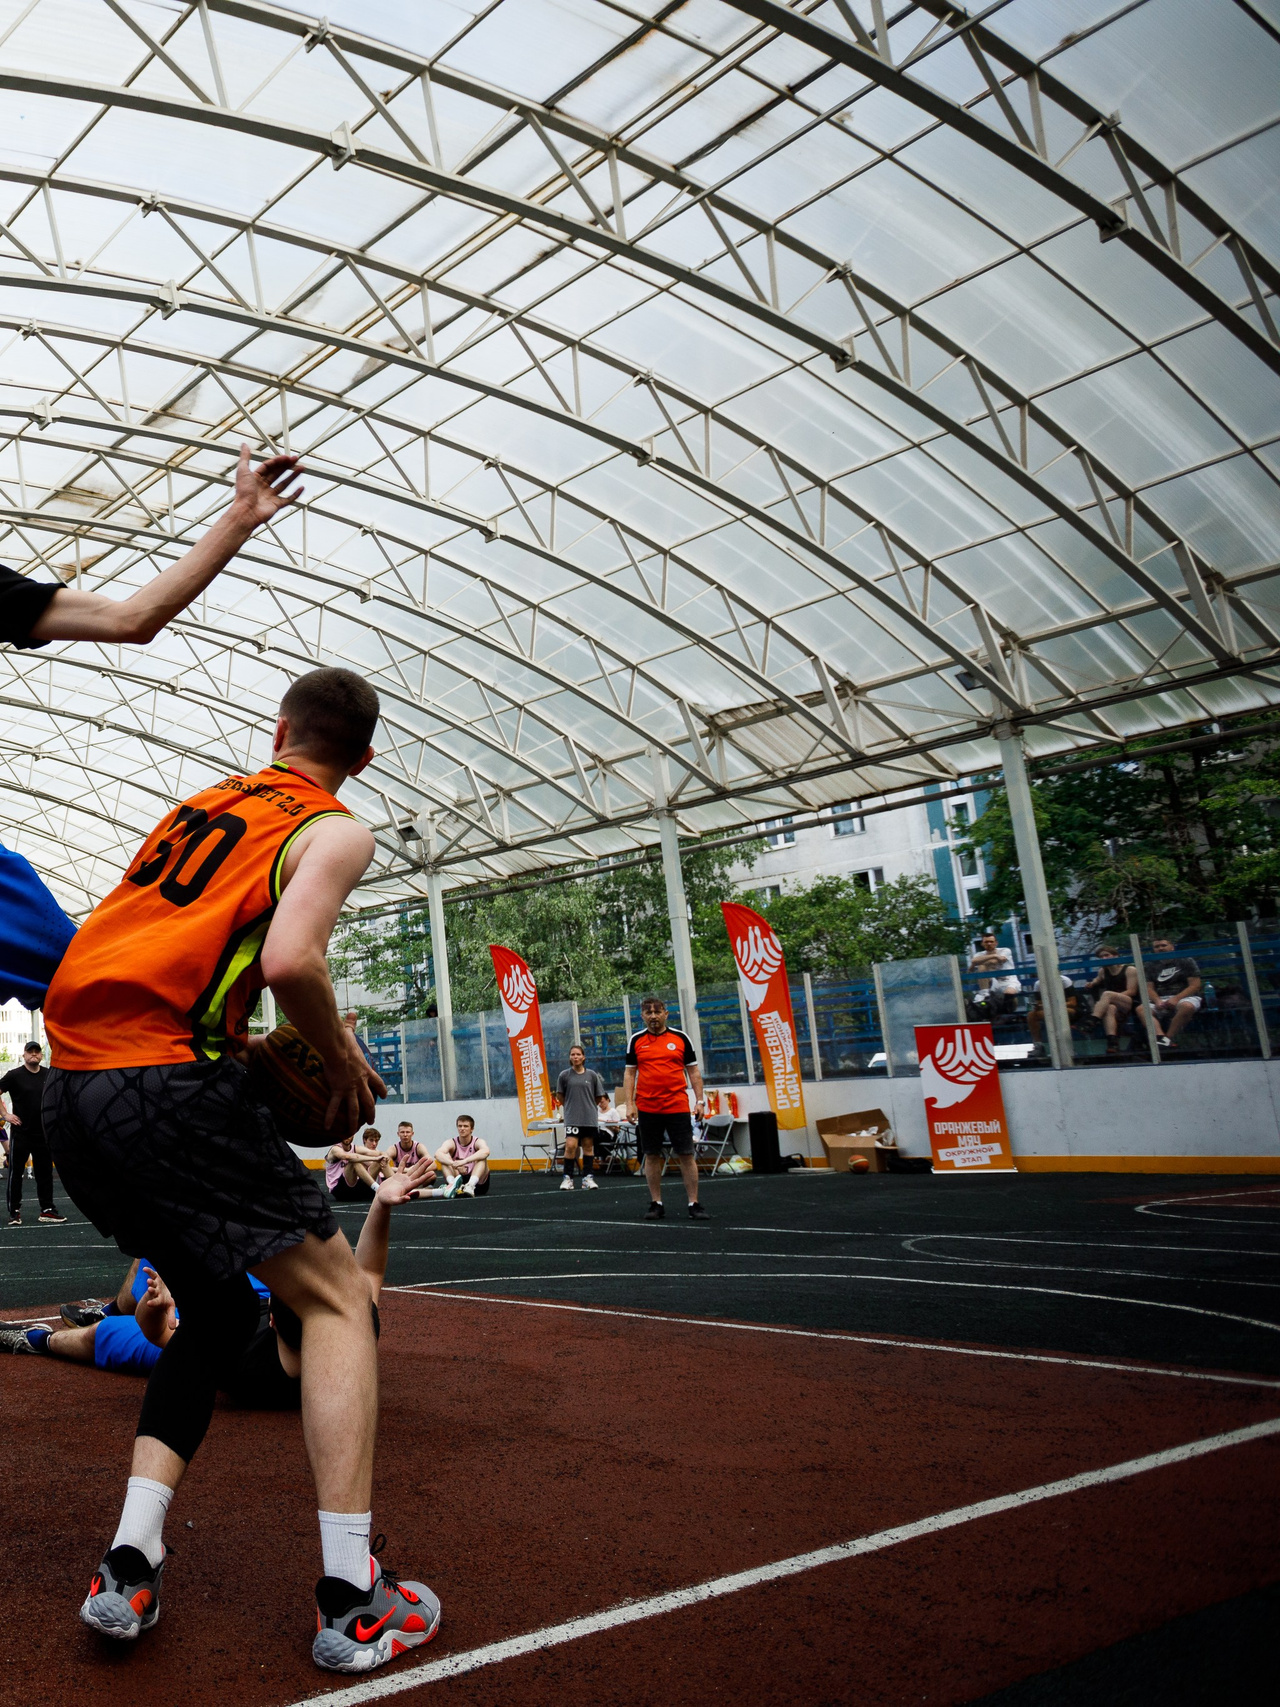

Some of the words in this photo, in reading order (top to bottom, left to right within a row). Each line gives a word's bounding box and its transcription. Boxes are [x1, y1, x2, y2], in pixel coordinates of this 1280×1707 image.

[276, 796, 306, 816] 2.0
[127, 805, 247, 907] 30
[756, 1013, 791, 1110] ОРАНЖЕВЫЙ
[516, 1038, 535, 1119] ОРАНЖЕВЫЙ
[785, 1073, 801, 1108] МЯЧ
[531, 1088, 547, 1118] МЯЧ
[566, 1126, 579, 1135] 30
[933, 1119, 1002, 1134] ОРАНЖЕВЫЙ
[945, 1145, 994, 1157] ОКРУЖНОЙ
[957, 1135, 982, 1148] МЯЧ
[961, 1156, 983, 1164] ЭТАП
